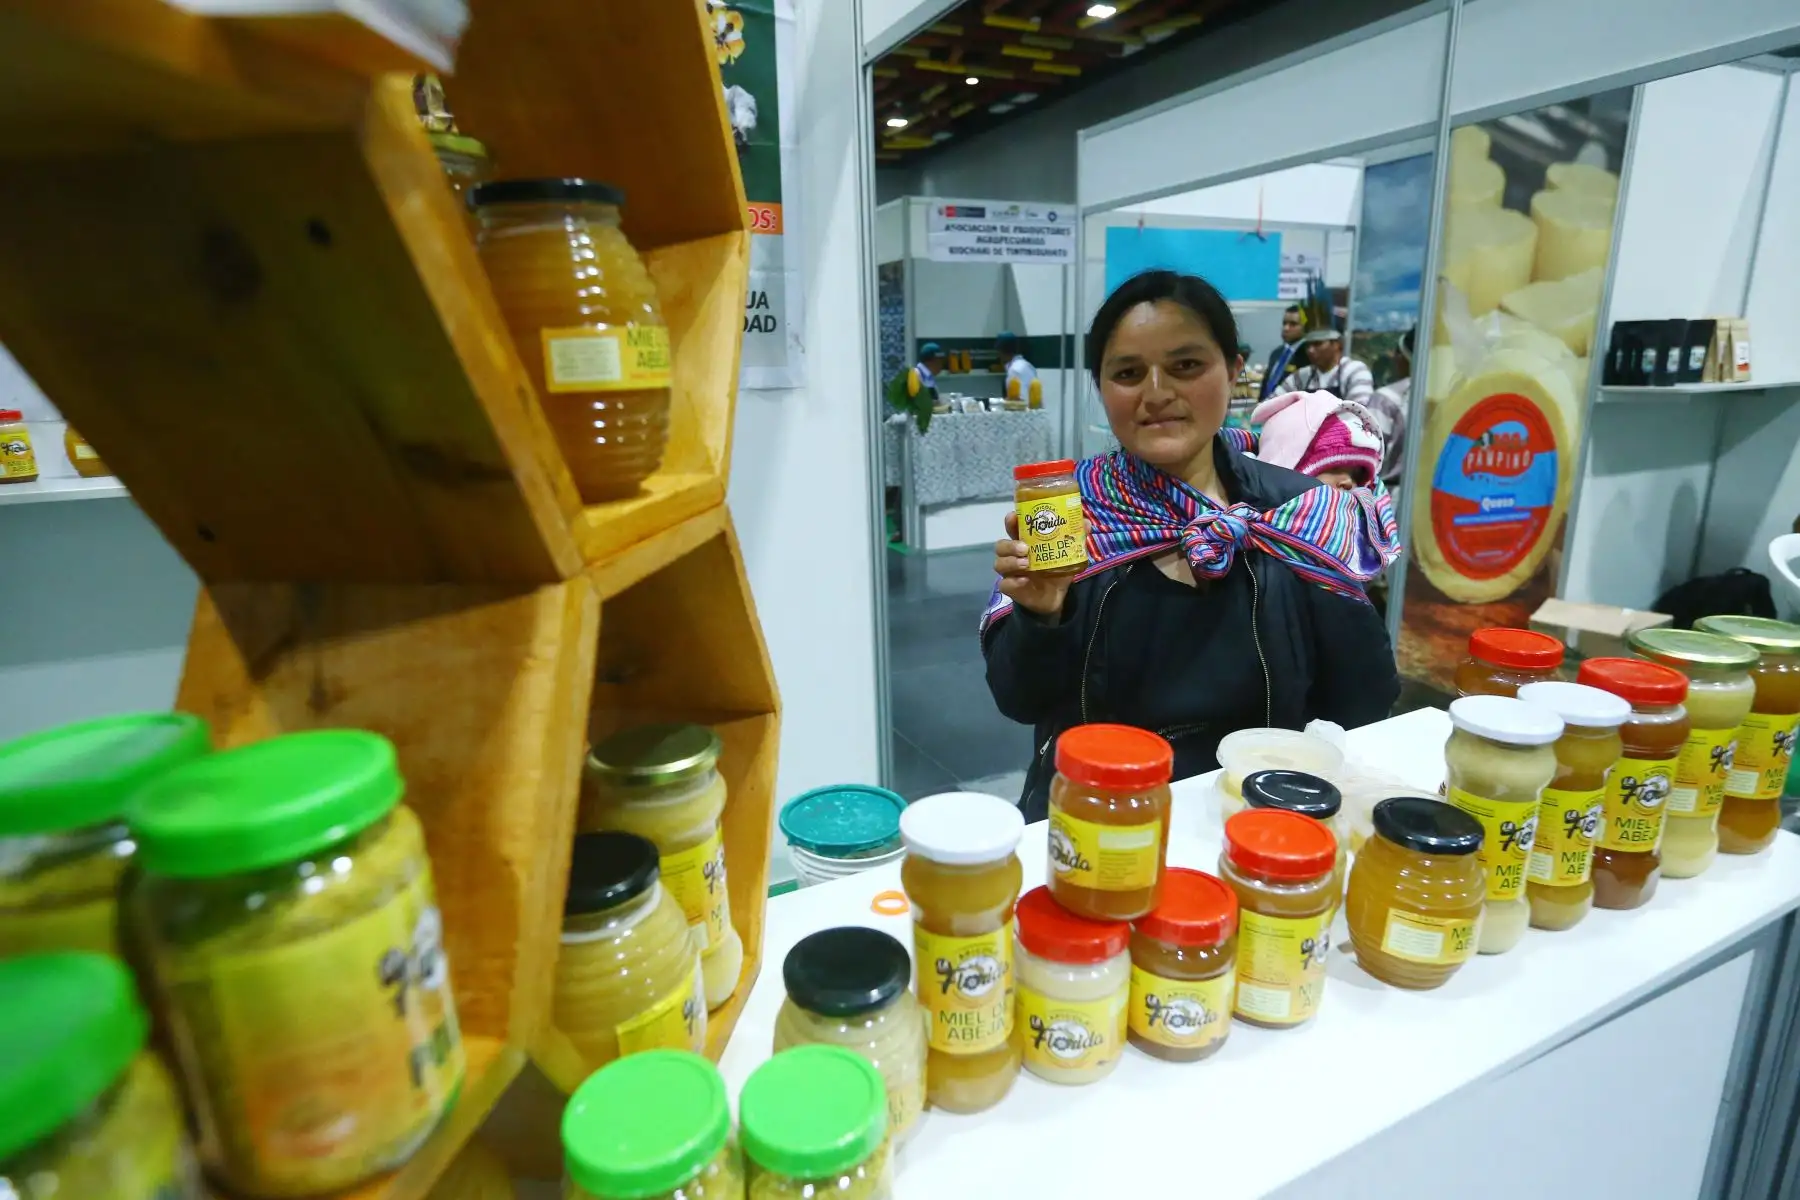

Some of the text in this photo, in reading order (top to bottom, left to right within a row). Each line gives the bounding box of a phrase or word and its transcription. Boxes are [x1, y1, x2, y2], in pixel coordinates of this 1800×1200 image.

[743, 314, 777, 333] AD
[1024, 513, 1068, 537] Florida
[1030, 539, 1071, 554] MIEL DE
[1035, 549, 1069, 562] ABEJA
[1615, 816, 1652, 829] MIEL
[1144, 993, 1219, 1027] Florida
[1029, 1014, 1104, 1050] Florida
